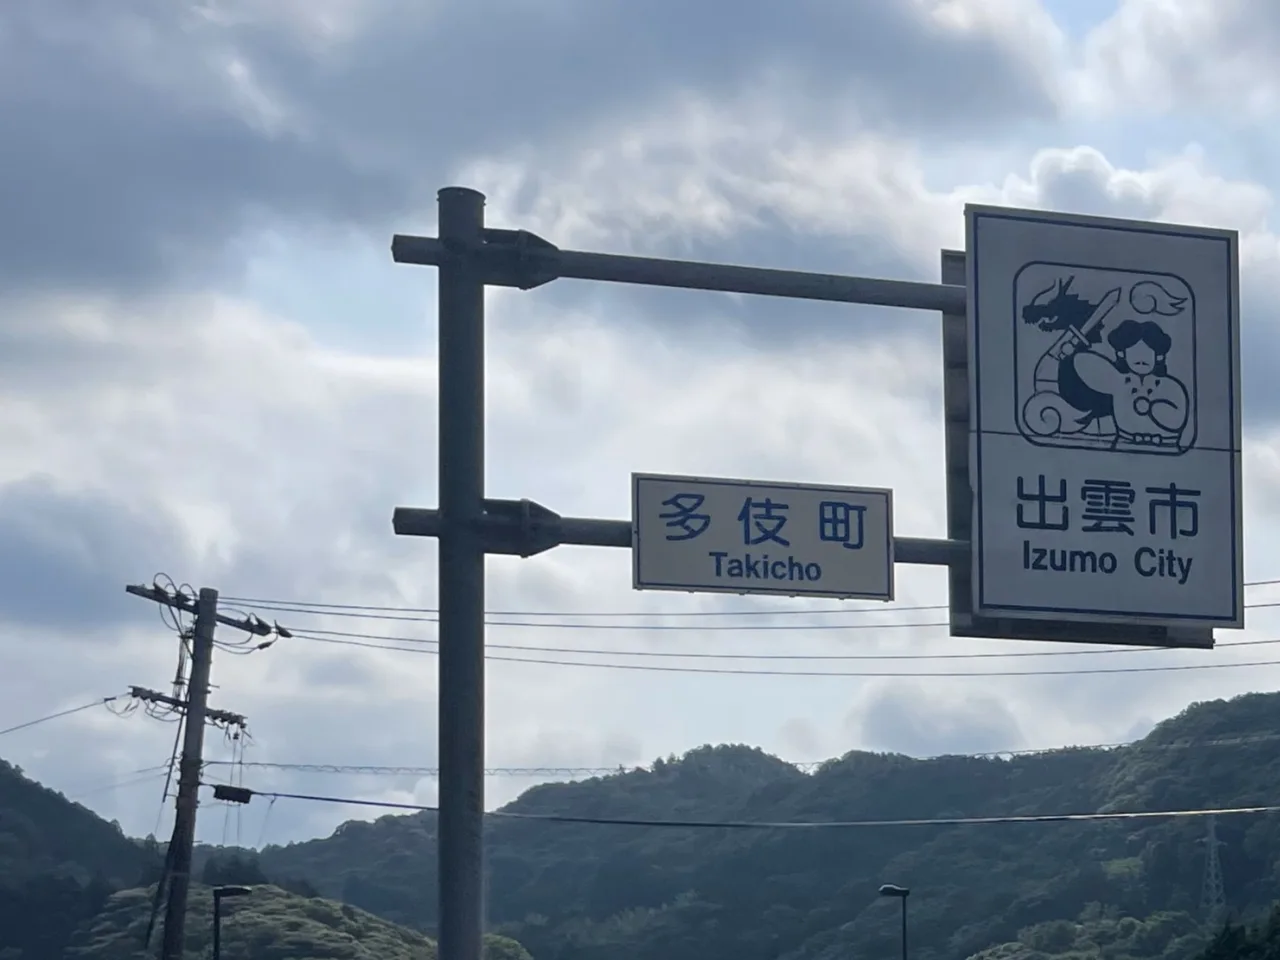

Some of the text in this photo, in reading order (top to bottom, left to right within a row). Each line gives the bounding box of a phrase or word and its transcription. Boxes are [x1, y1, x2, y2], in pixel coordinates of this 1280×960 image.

[659, 493, 867, 549] 多伎町
[1017, 474, 1201, 539] 出雲市
[709, 551, 822, 581] Takicho
[1024, 540, 1193, 584] Izumo City
